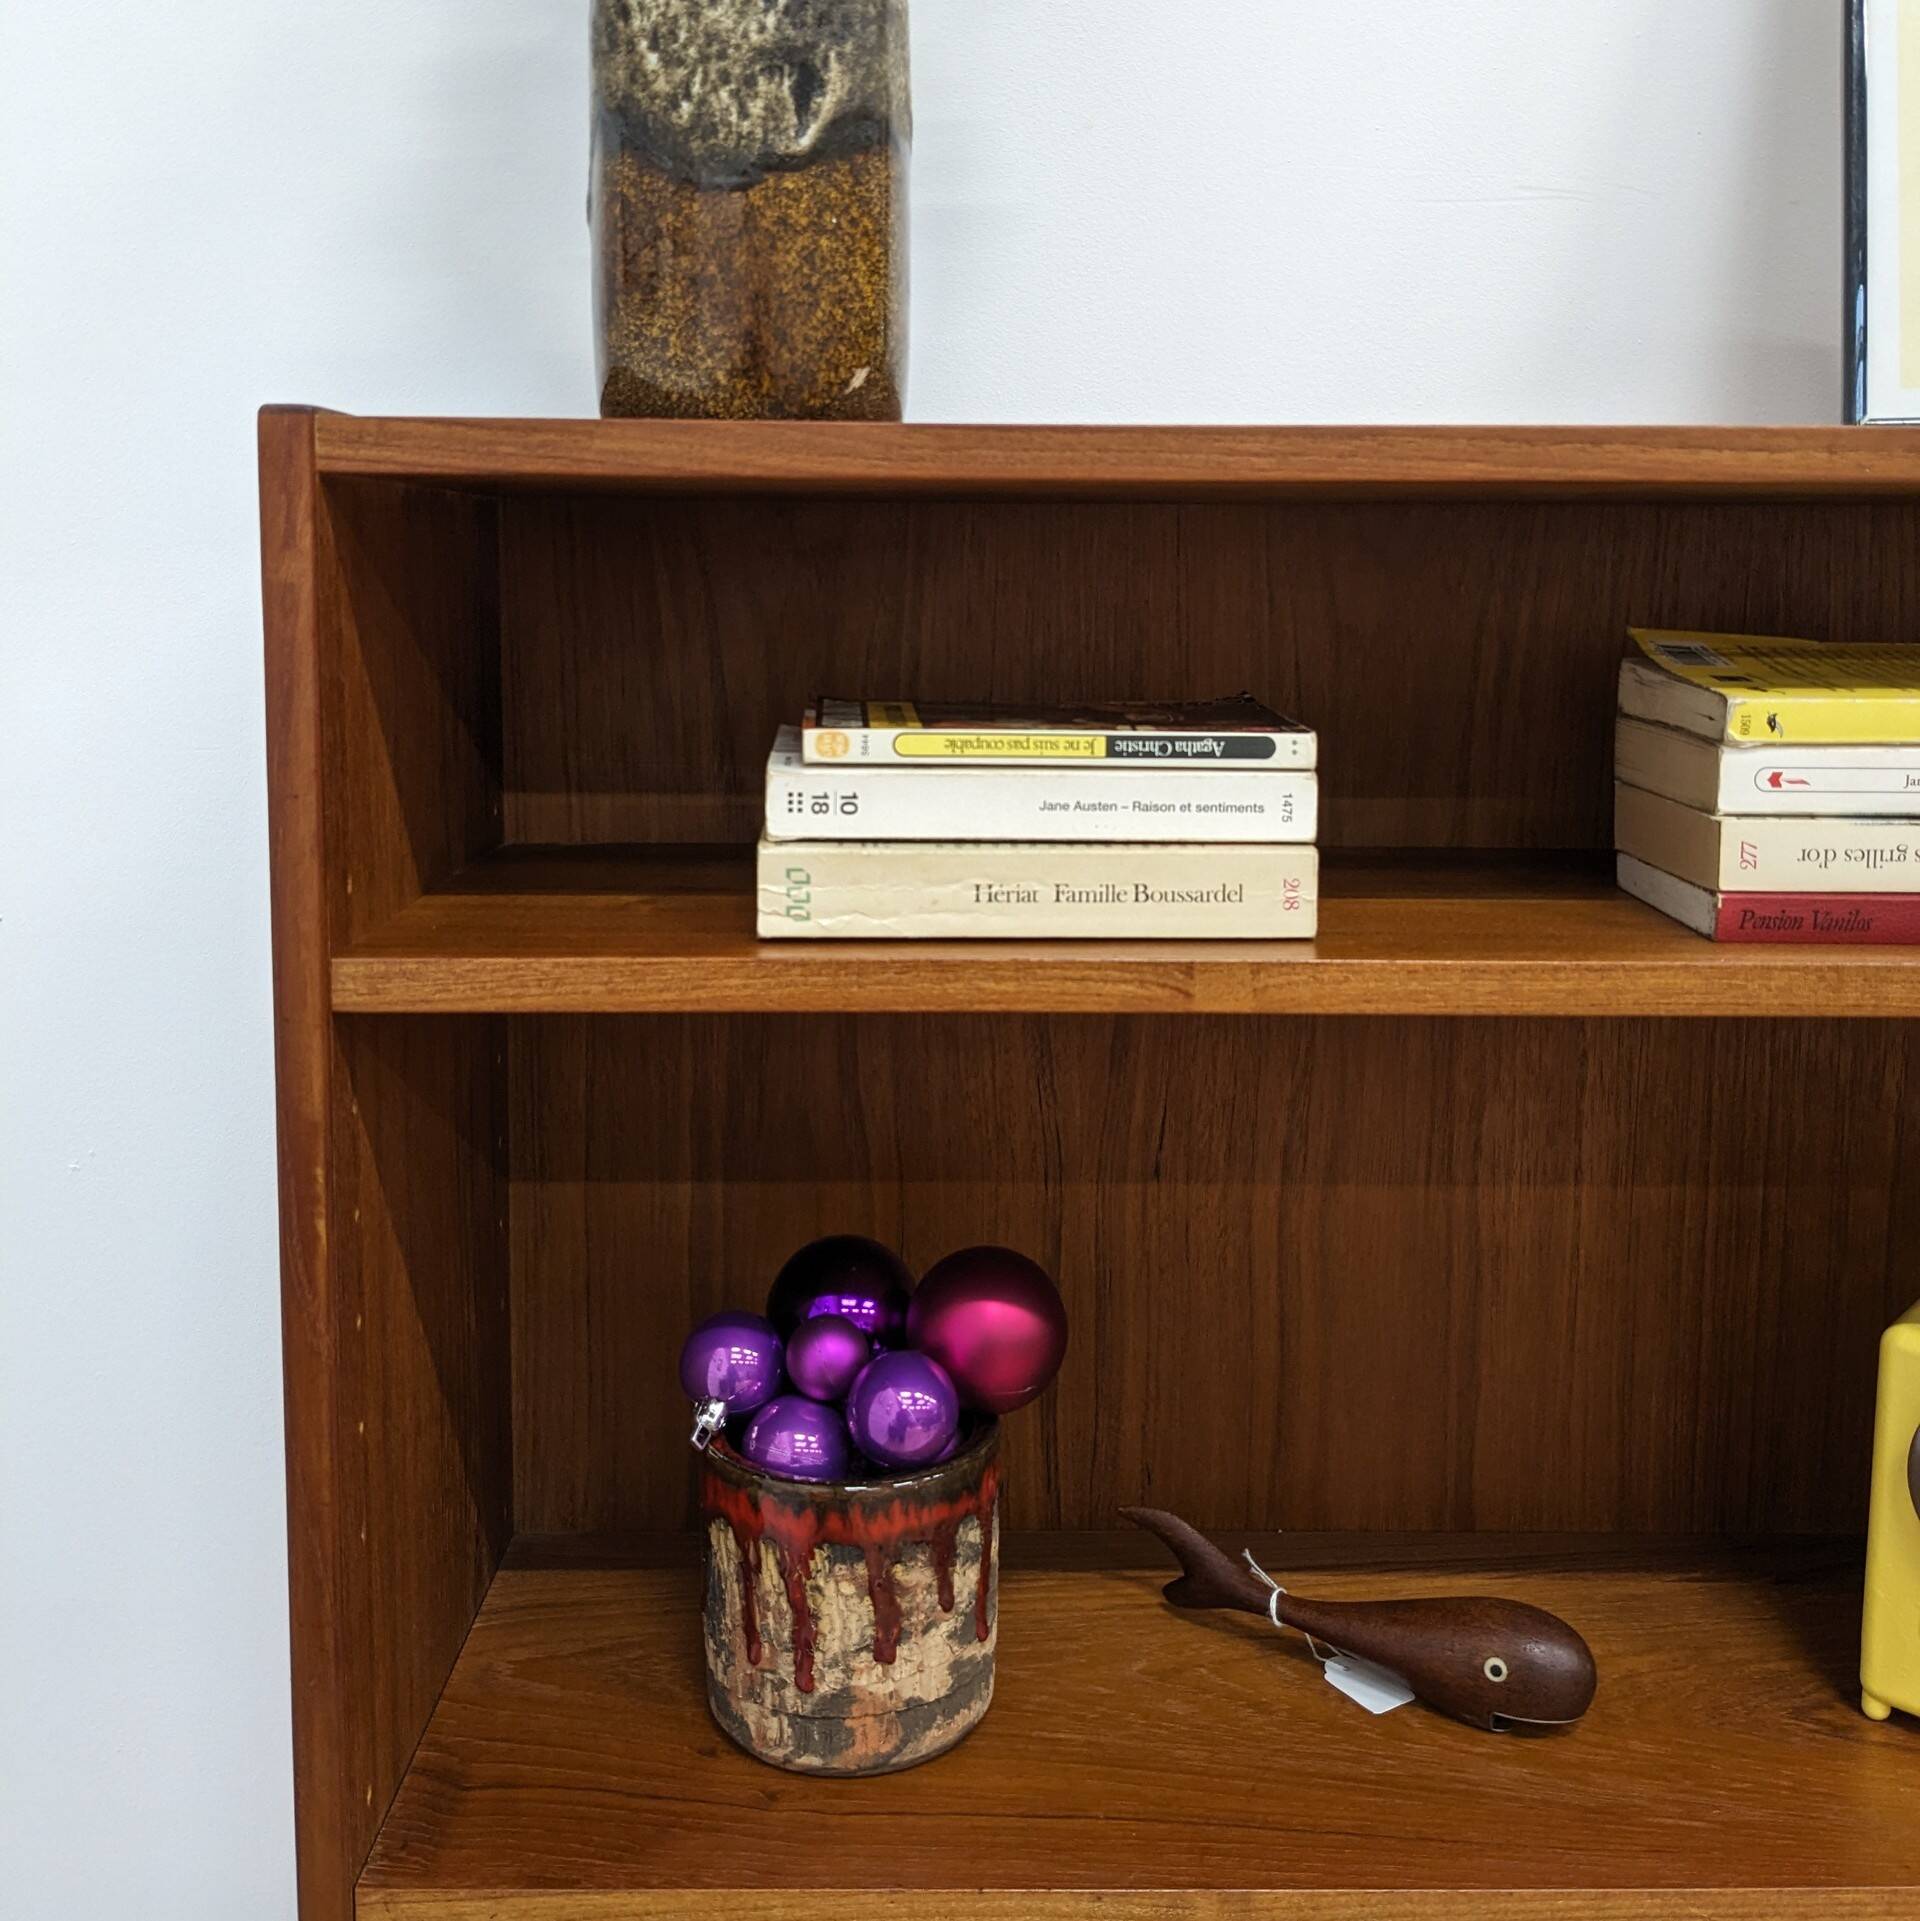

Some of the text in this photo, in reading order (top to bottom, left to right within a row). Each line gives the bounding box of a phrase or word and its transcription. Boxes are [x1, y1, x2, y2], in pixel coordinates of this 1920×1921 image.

[944, 737, 1226, 758] Agatha Christie Je ne suis pas coupable
[811, 792, 830, 815] 18
[840, 792, 859, 815] 10
[1038, 800, 1071, 813] Jane
[1073, 800, 1118, 813] Austen
[1132, 801, 1176, 813] Raison
[1179, 802, 1192, 813] et
[1195, 801, 1265, 814] sentiments
[1281, 793, 1293, 823] 1475
[1739, 841, 1758, 870] 277
[1797, 849, 1837, 869] d'or
[1844, 844, 1908, 869] grilles
[973, 883, 1244, 903] Hériat Famille Boussardel
[1282, 878, 1300, 911] 208
[1738, 909, 1874, 932] Pension Vanilos
